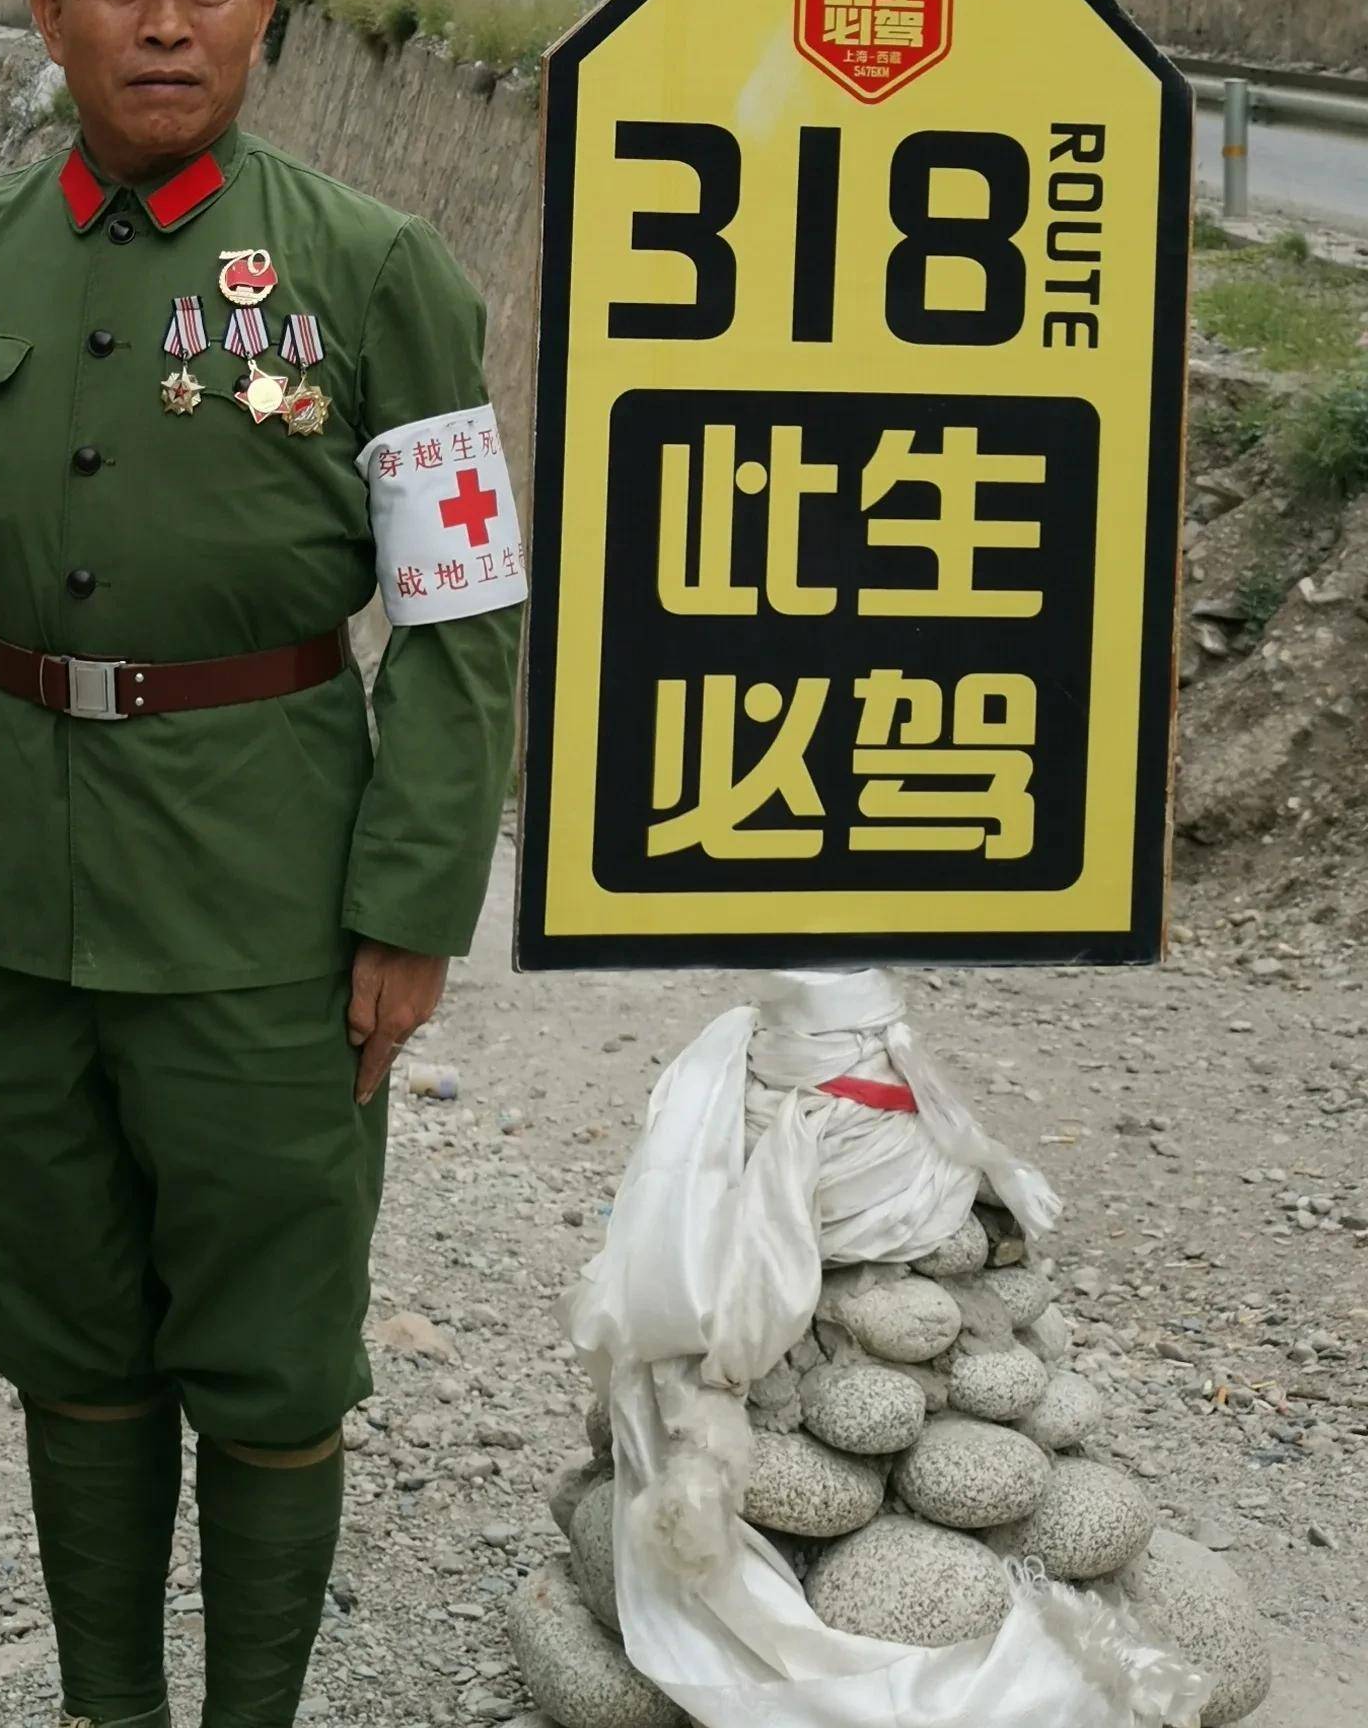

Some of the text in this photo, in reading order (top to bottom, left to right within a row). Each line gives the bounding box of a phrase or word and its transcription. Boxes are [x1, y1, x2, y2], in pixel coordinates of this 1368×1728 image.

[822, 7, 924, 47] 必驾
[608, 120, 1030, 346] 318
[1042, 122, 1106, 349] ROUTE
[377, 429, 502, 479] 穿越生死
[657, 424, 1047, 618] 此生
[647, 668, 1038, 860] 必驾
